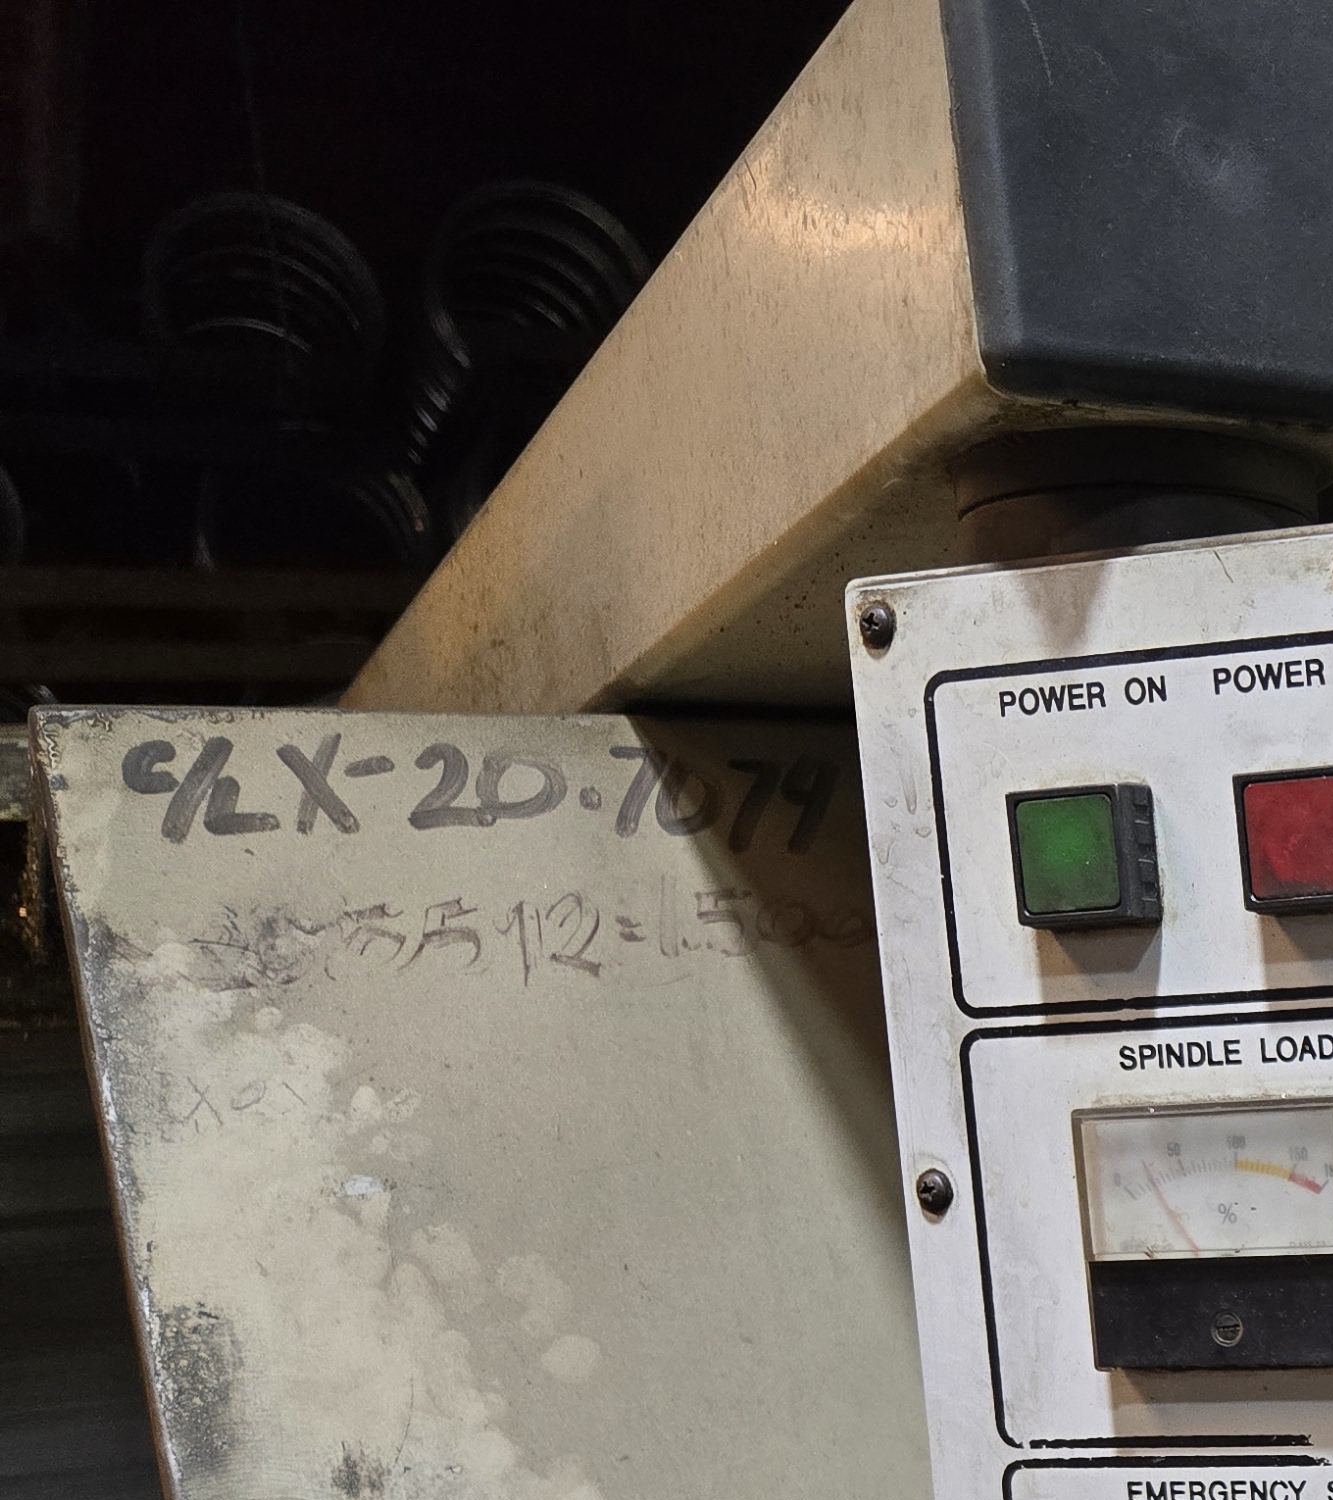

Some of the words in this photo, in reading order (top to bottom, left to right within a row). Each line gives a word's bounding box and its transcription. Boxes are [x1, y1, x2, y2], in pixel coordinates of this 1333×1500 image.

[1213, 659, 1326, 695] POWER
[999, 681, 1106, 716] POWER
[1124, 675, 1167, 705] ON
[1118, 1039, 1243, 1071] SPINDLE
